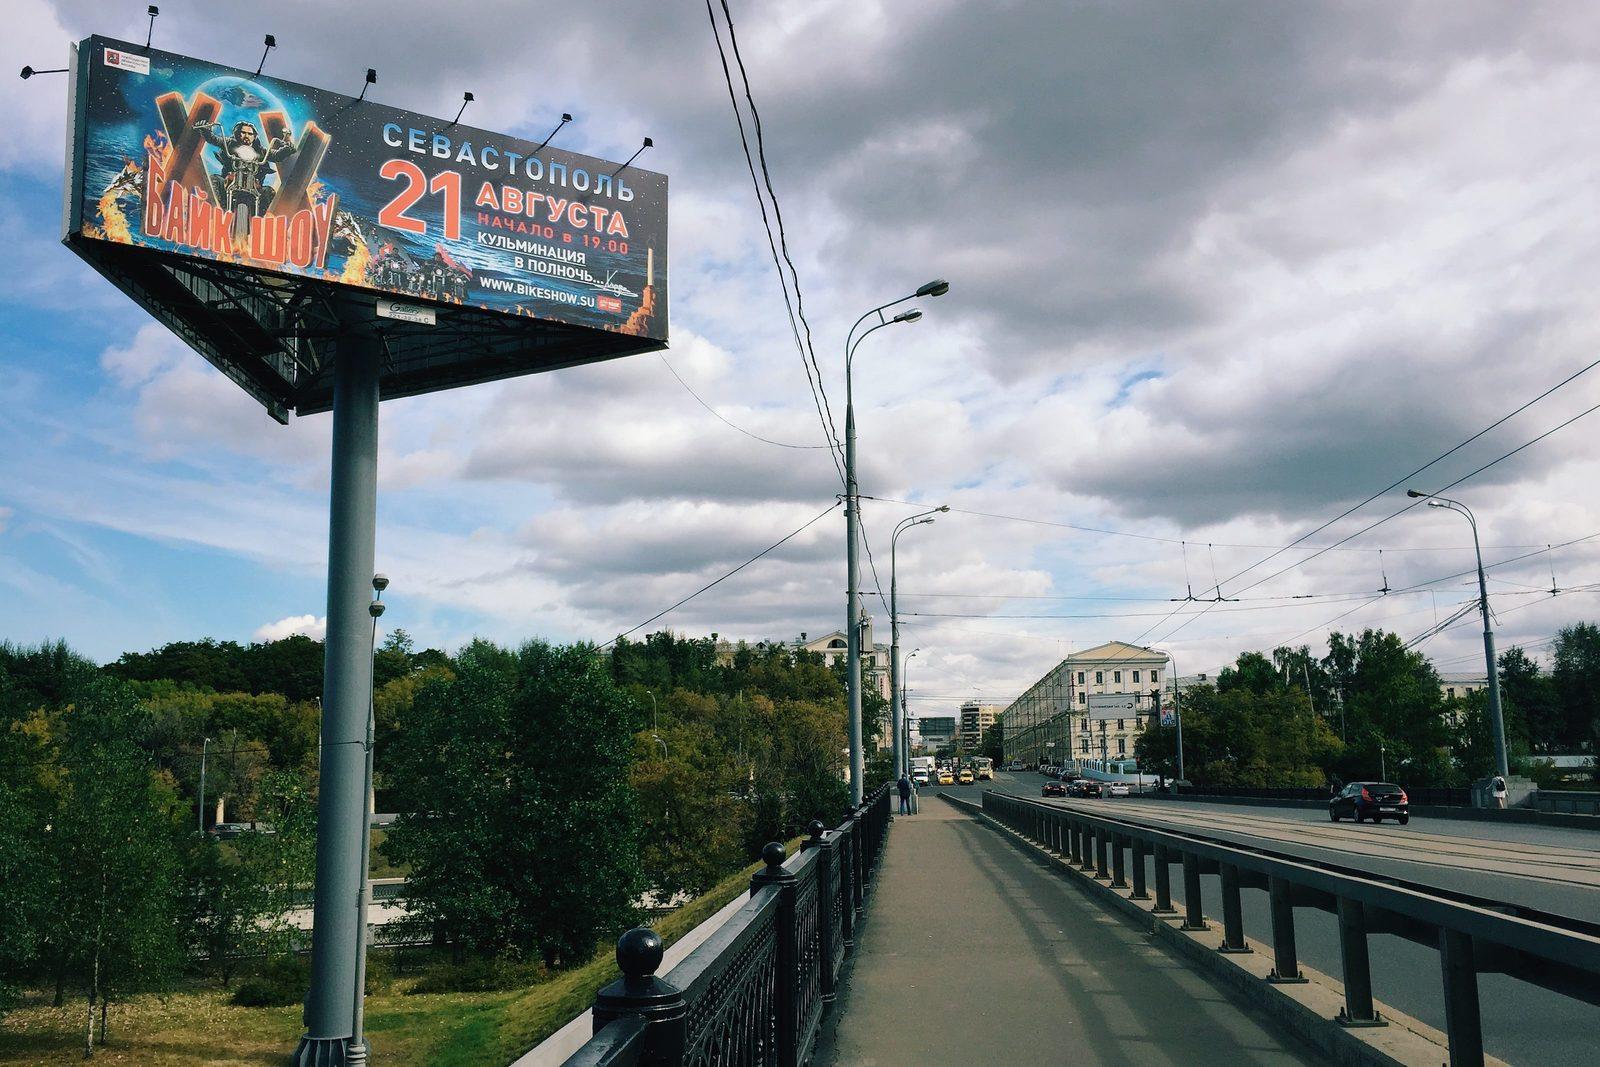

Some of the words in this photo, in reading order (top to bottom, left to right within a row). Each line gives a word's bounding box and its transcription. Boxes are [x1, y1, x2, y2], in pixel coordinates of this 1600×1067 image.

[382, 123, 635, 202] СЕВАСТОПОЛЬ
[145, 153, 234, 254] БАЙК
[251, 193, 337, 268] ШОУ
[378, 158, 462, 242] 21
[475, 181, 629, 238] АВГУСТА
[477, 212, 554, 239] НАЧАЛО
[583, 234, 629, 255] 19.00
[477, 231, 587, 264] КУЛЬМИНАЦИЯ
[480, 276, 595, 307] WWW.BIKESHOW.SU
[514, 256, 525, 269] В
[528, 261, 604, 284] ПОЛНОЧЬ...
